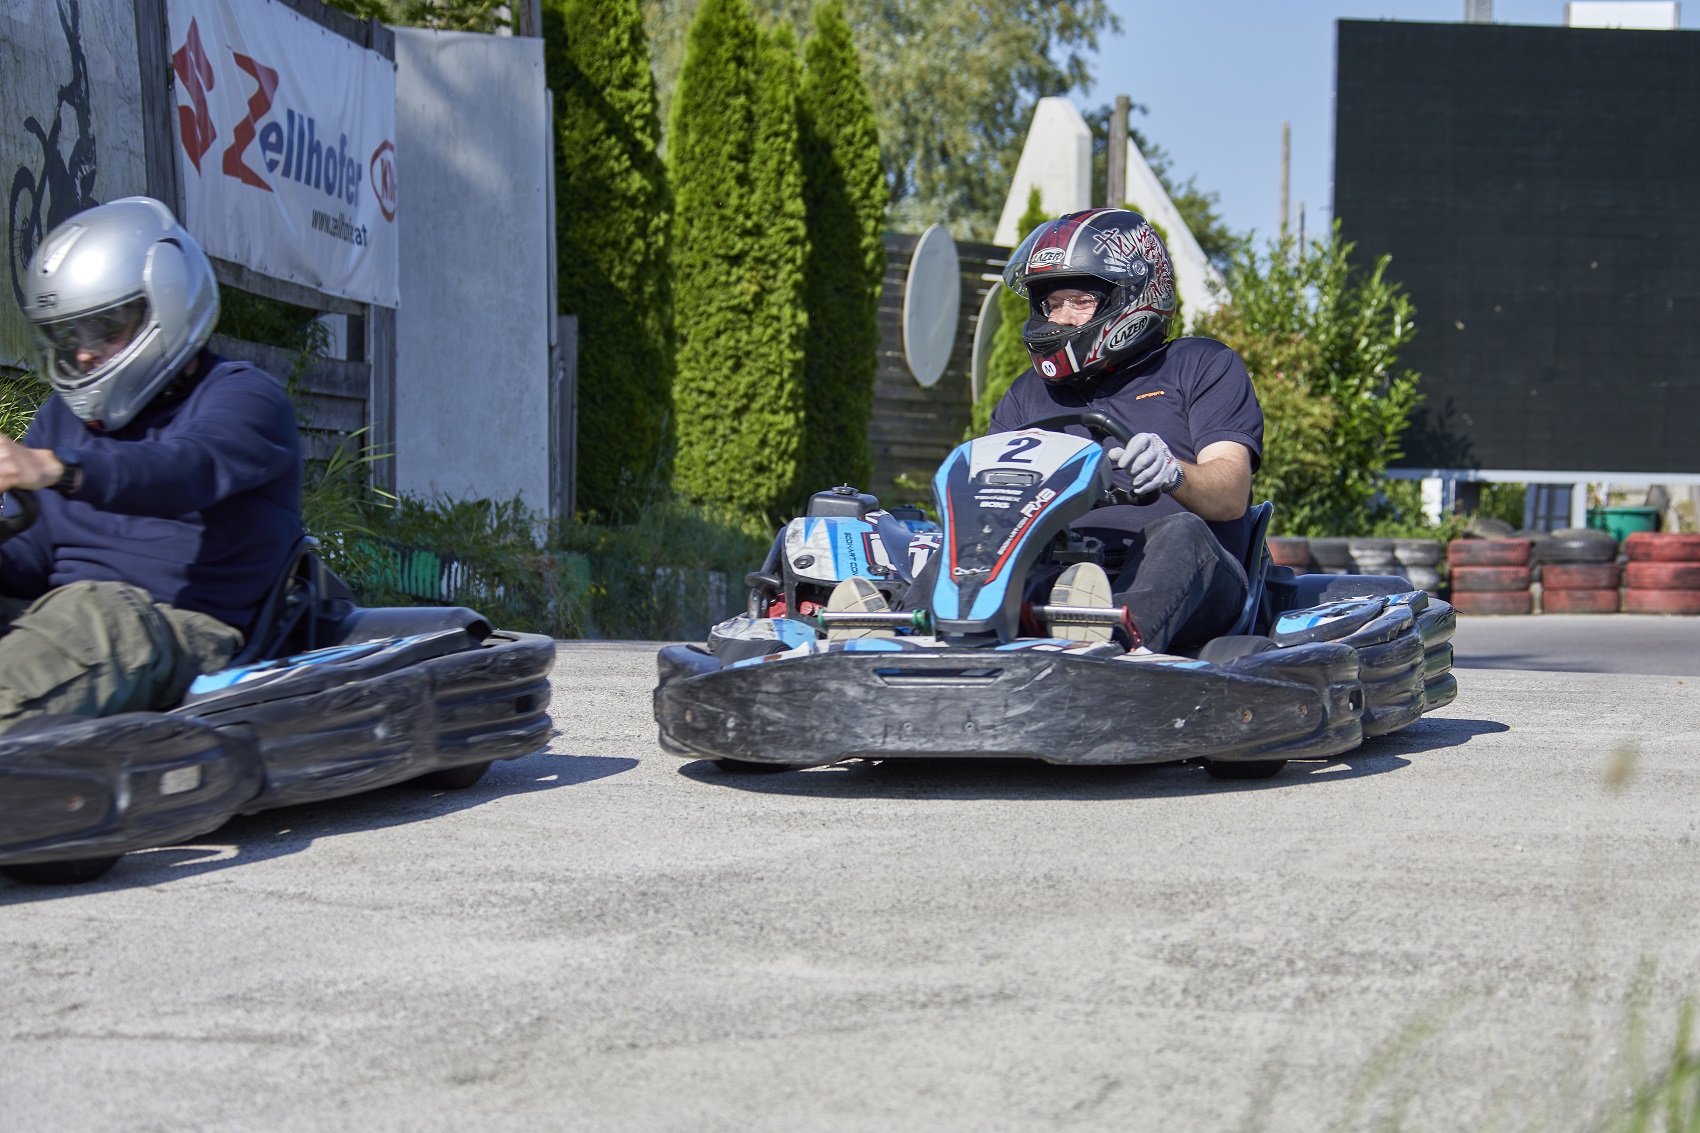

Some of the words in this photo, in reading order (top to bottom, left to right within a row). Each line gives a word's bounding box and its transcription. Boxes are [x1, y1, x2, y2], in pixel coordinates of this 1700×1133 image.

[222, 46, 362, 207] Zellhofer
[1033, 251, 1063, 262] LAZER
[1114, 317, 1148, 345] LAZER
[1044, 364, 1055, 374] M
[997, 436, 1042, 464] 2
